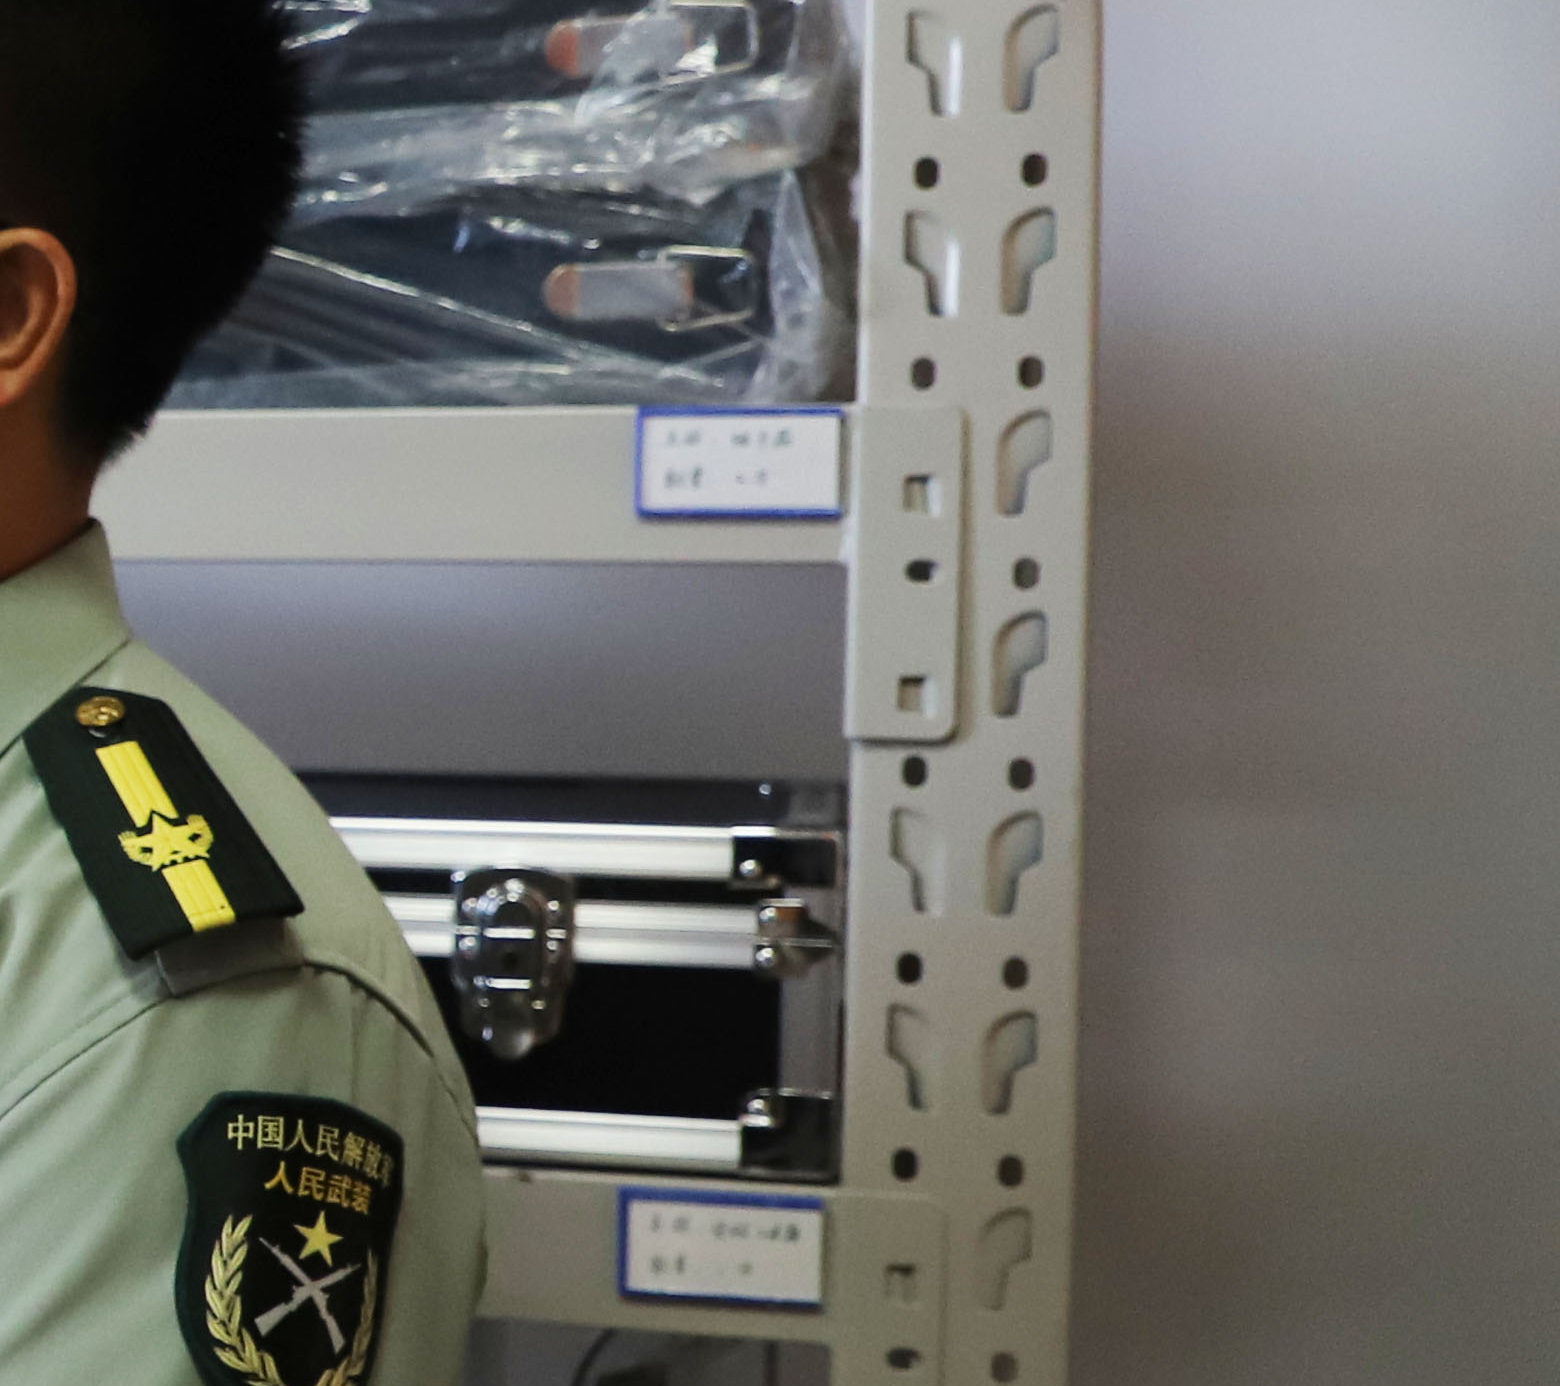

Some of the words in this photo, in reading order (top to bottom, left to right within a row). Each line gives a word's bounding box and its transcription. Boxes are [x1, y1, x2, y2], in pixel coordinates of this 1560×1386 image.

[226, 1114, 396, 1188] 中国人民解放军
[264, 1161, 374, 1214] 人民武装
